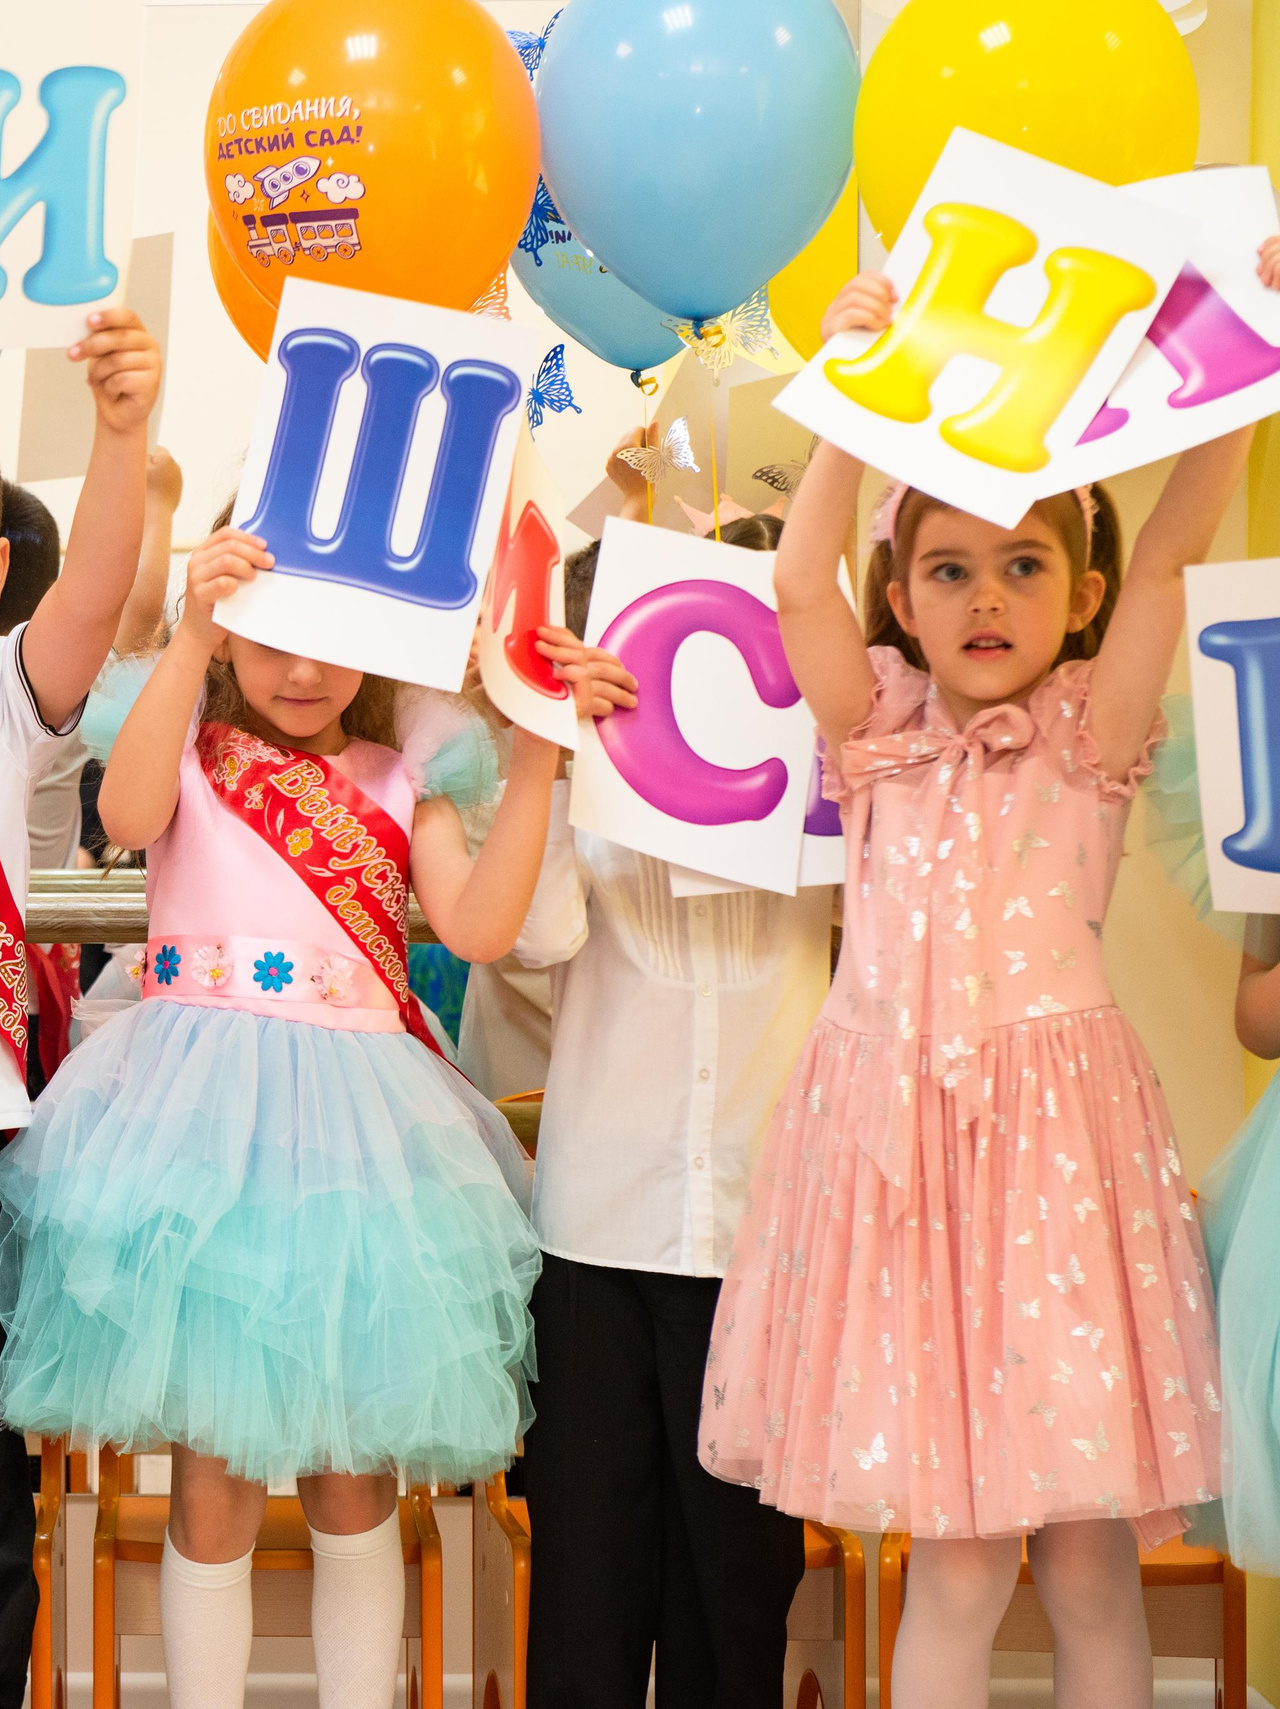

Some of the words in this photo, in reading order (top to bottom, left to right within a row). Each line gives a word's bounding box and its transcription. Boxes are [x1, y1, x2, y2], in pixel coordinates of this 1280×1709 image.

[216, 113, 237, 138] ДО
[240, 95, 362, 131] СВИДАНИЯ,
[217, 128, 295, 161] ДЕТСКИЙ
[304, 125, 364, 147] САД!
[823, 202, 1157, 473] Н
[238, 327, 522, 610] Ш
